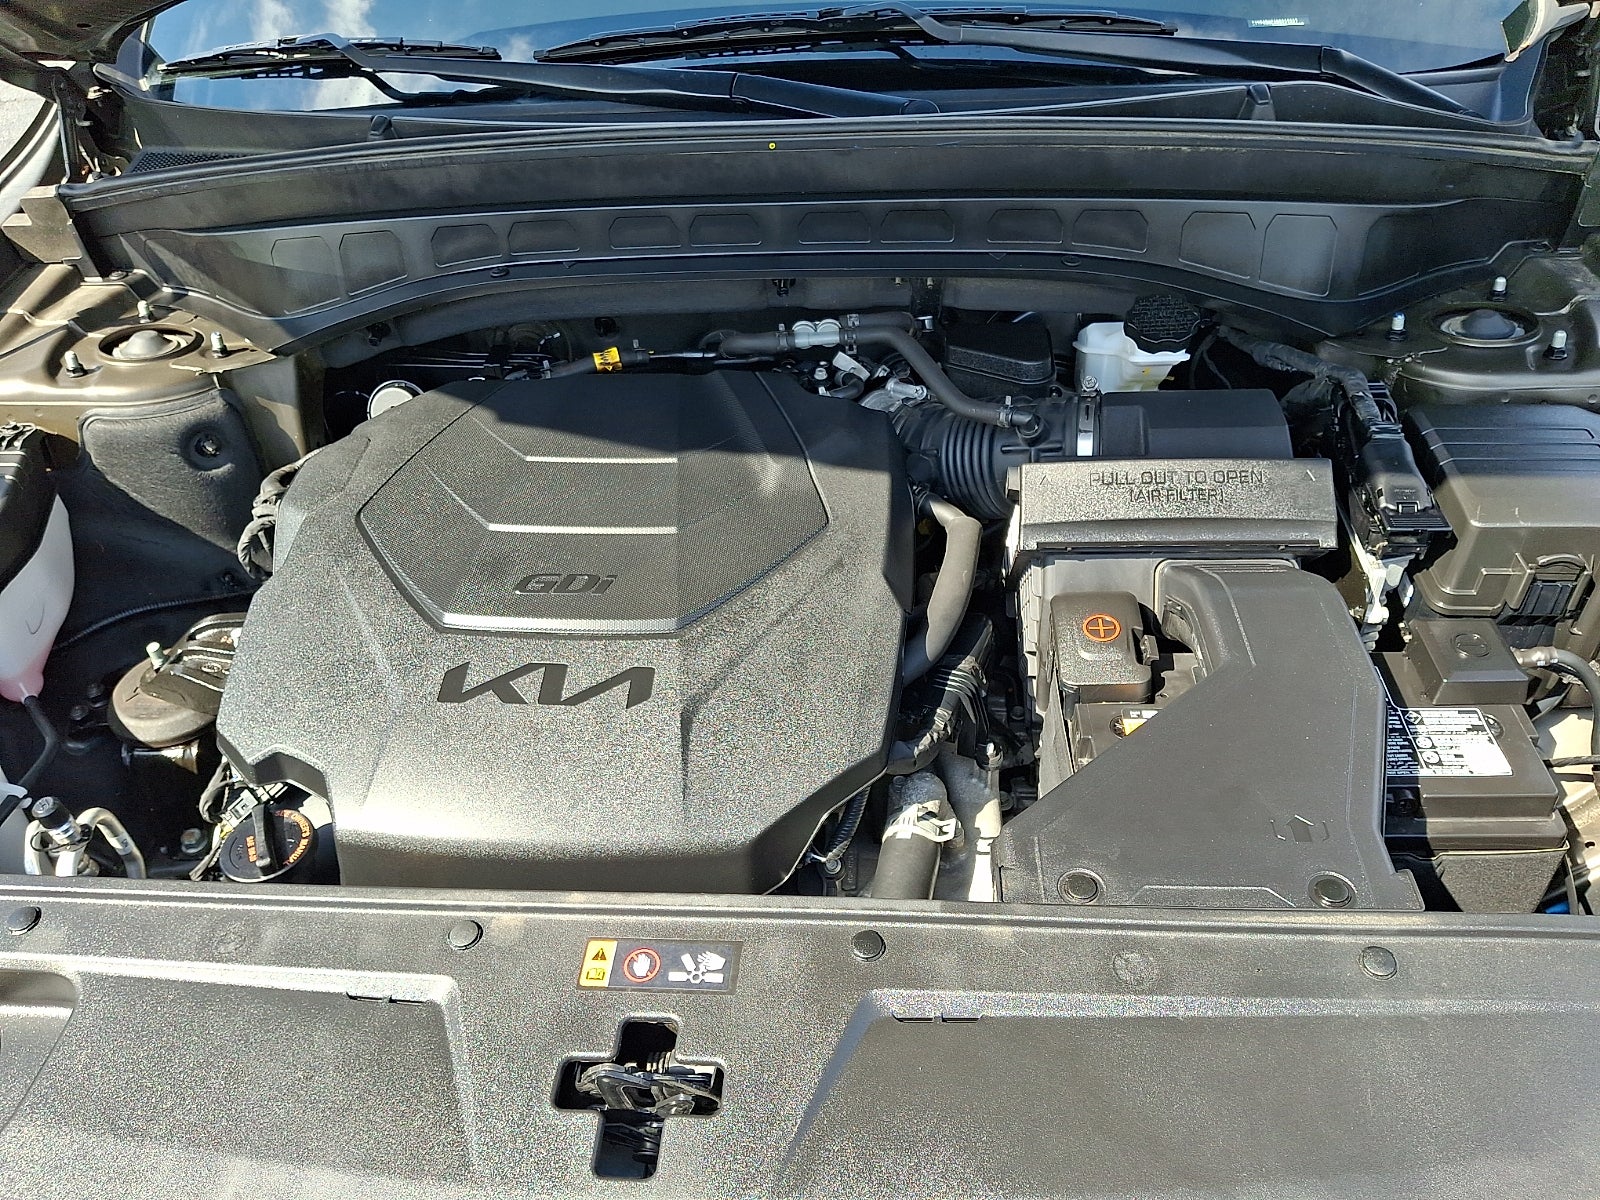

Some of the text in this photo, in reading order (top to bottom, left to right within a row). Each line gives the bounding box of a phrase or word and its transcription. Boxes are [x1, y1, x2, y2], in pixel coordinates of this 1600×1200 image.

[1090, 470, 1264, 486] PULL OUT TO OPEN
[514, 573, 618, 595] GDi
[437, 660, 656, 709] KIA
[283, 838, 309, 866] MANUAL
